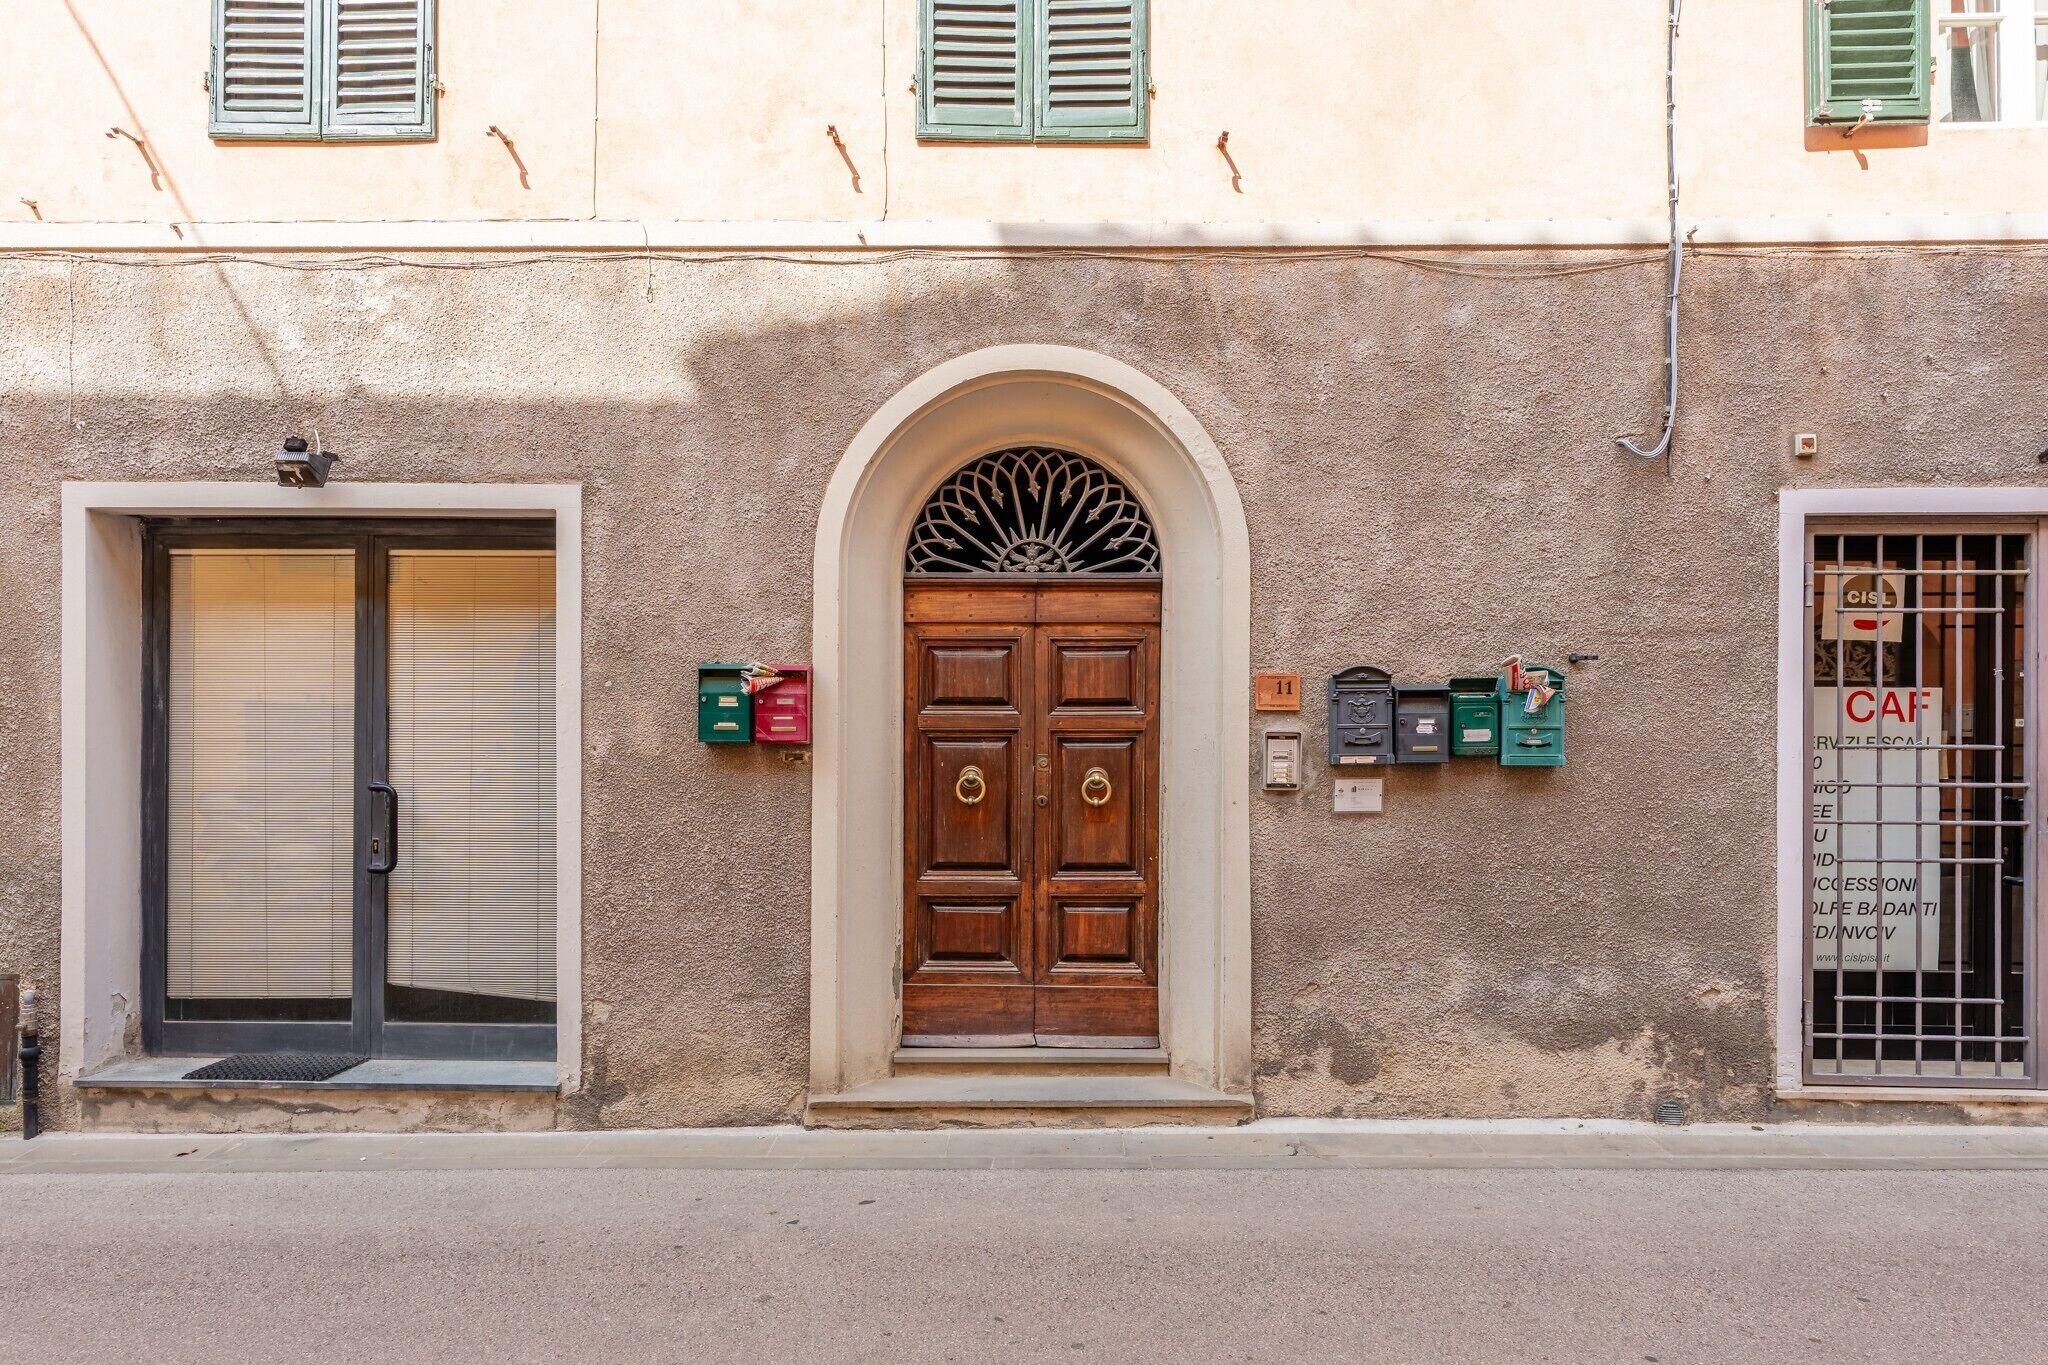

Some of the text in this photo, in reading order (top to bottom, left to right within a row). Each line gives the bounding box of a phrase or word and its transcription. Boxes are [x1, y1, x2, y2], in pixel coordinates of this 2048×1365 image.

[1847, 590, 1891, 605] CISL
[1276, 680, 1293, 695] 11
[1846, 690, 1931, 723] CAF
